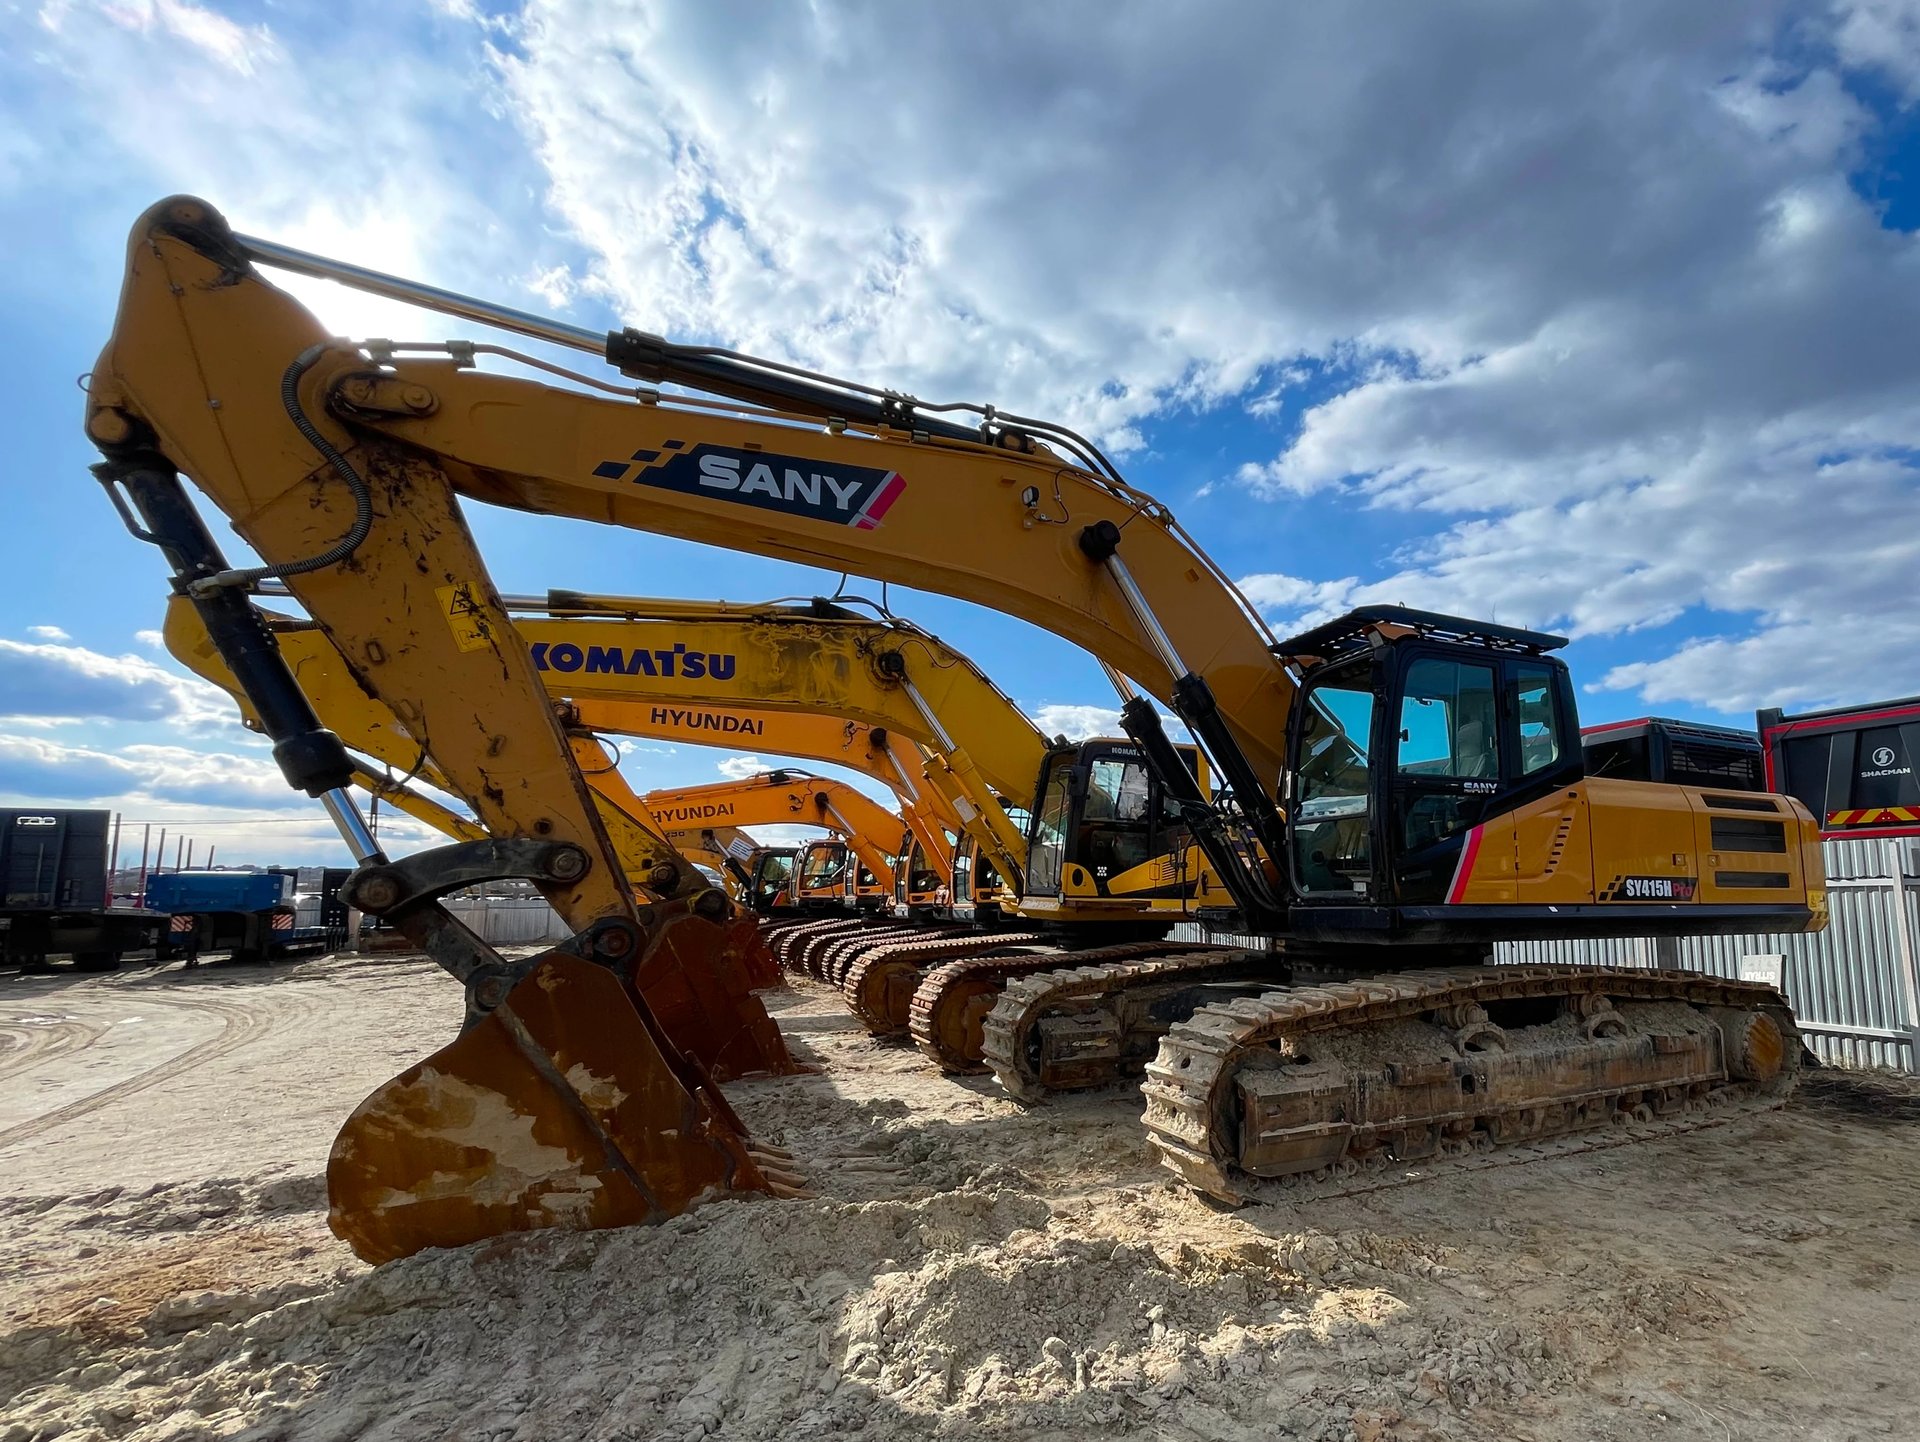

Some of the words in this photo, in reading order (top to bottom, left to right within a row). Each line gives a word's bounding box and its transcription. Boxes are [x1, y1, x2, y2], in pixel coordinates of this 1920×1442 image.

[699, 454, 863, 511] SANY
[530, 642, 736, 681] KOMATSU
[650, 707, 764, 736] HYUNDAI
[1861, 767, 1911, 778] SHACMAN
[1463, 782, 1498, 794] SANY
[650, 802, 735, 823] HYUNDAI
[1625, 879, 1673, 897] SY415H
[1672, 882, 1693, 897] Pro
